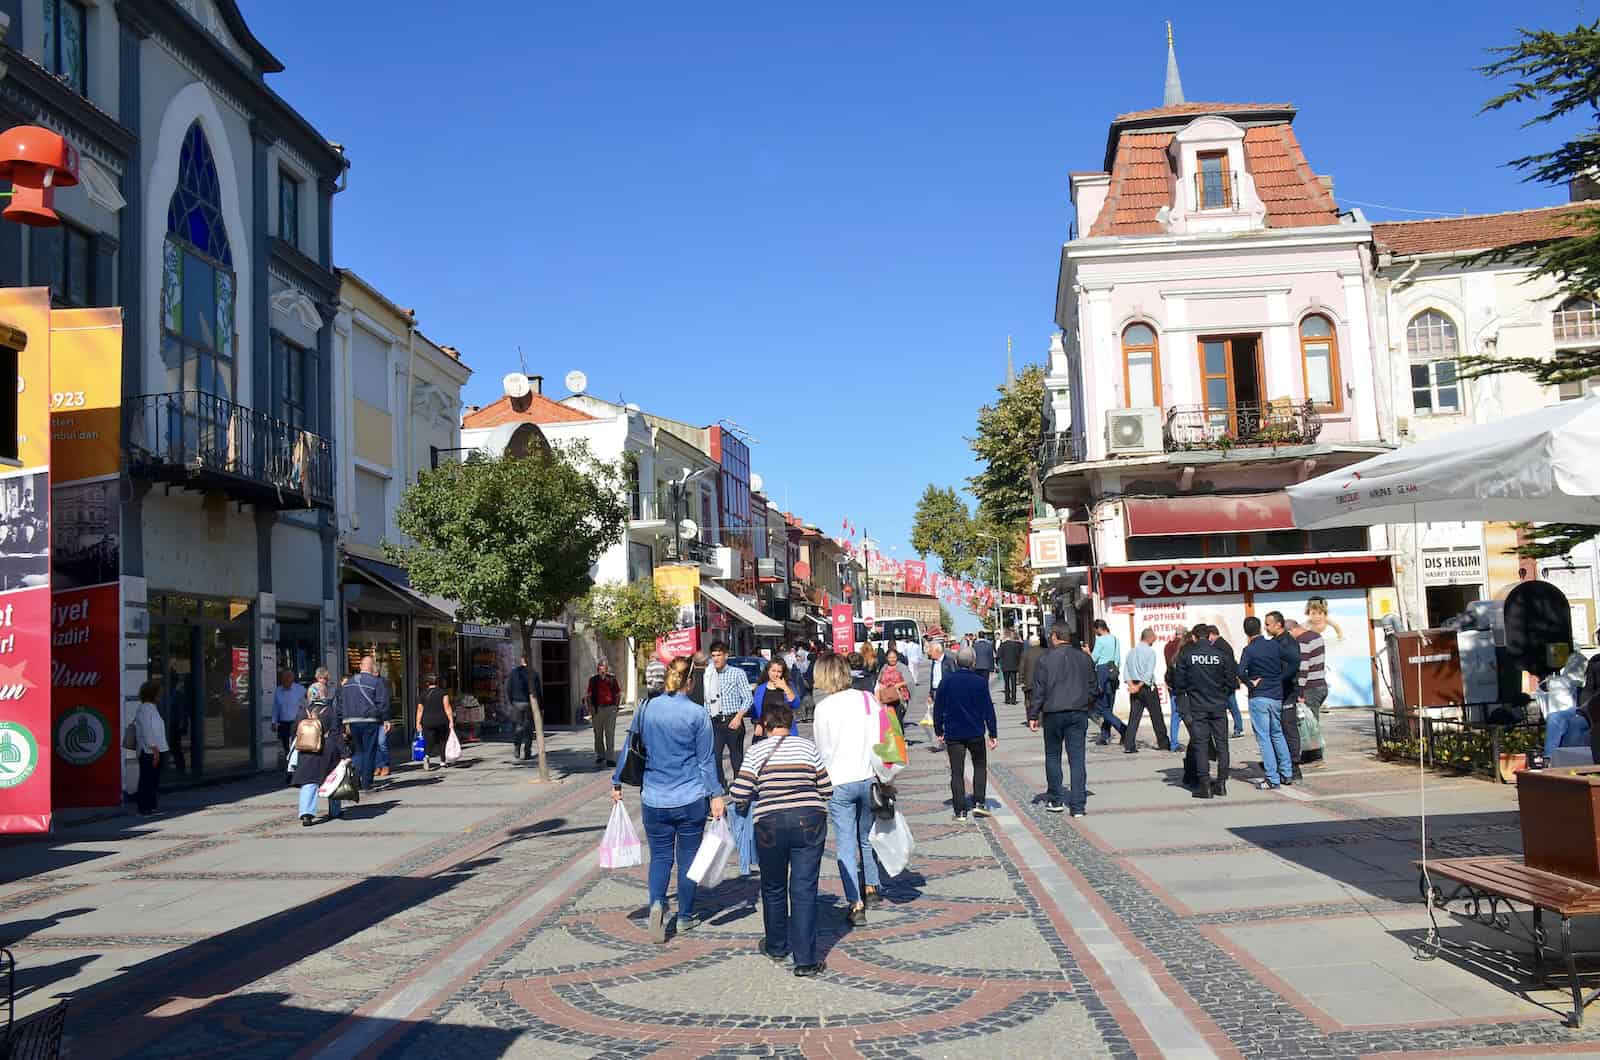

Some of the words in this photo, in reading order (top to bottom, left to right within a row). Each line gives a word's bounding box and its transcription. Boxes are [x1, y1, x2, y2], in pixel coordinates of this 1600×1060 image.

[49, 391, 85, 408] 923
[1139, 566, 1279, 595] eczane
[1292, 569, 1355, 586] Güven
